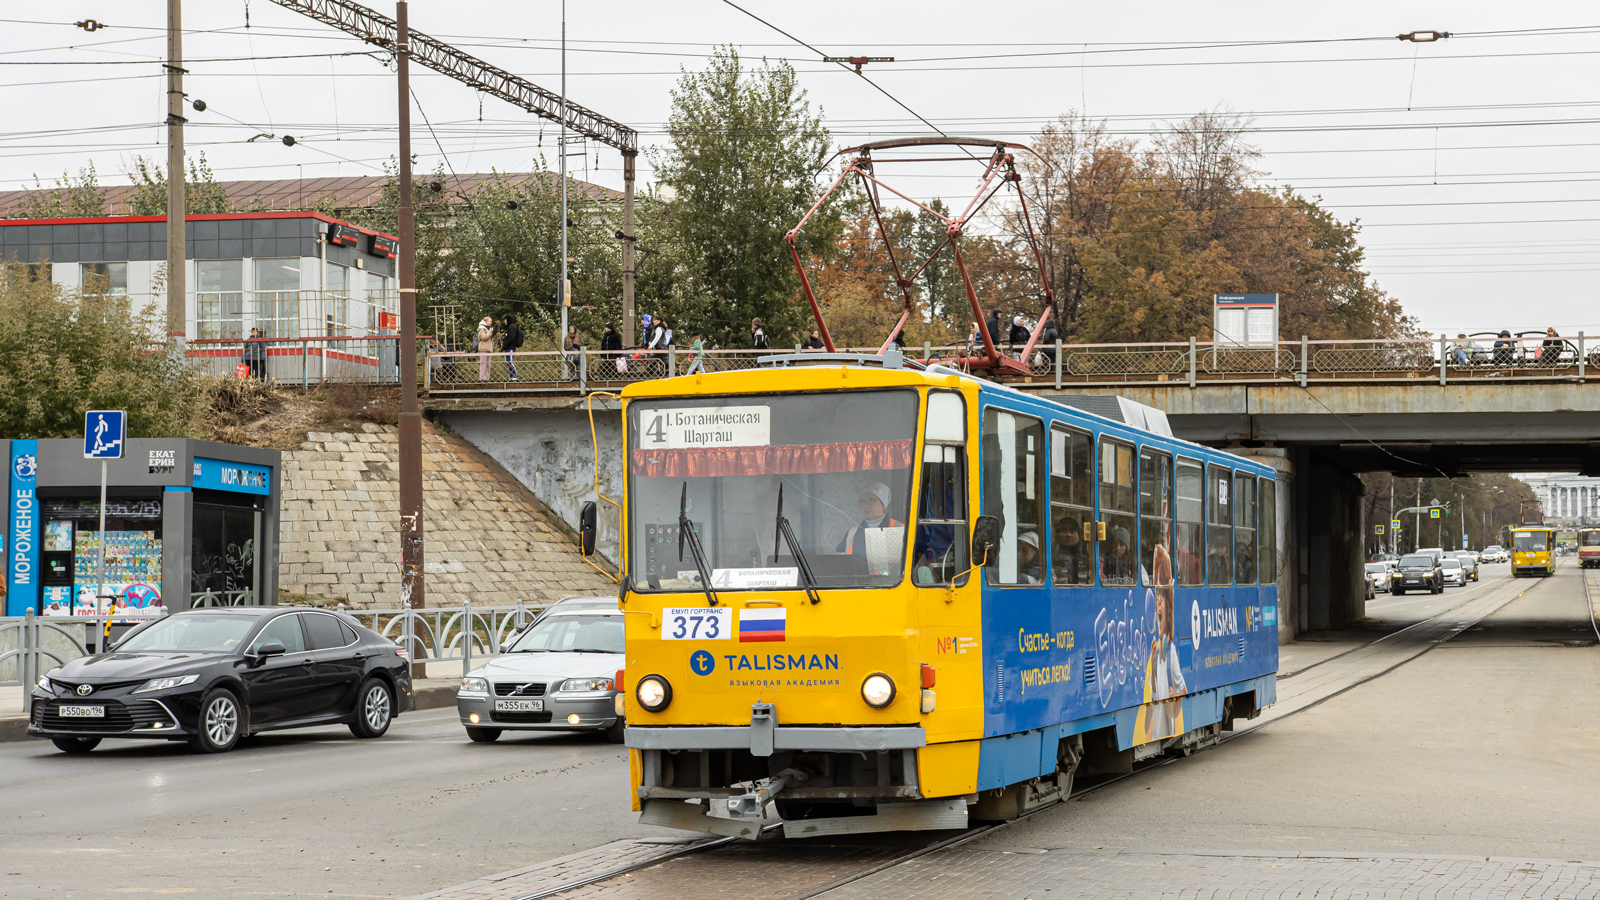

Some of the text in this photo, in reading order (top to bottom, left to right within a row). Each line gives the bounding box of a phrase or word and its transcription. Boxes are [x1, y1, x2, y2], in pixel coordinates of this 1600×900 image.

[645, 415, 667, 443] 4
[675, 412, 761, 427] Ботаническая
[684, 430, 733, 445] Шарташ
[149, 450, 175, 458] ЕКАТ
[149, 458, 175, 466] ЕРИН
[221, 467, 267, 488] МОРОЖЕНОЕ
[14, 489, 32, 584] МОРОЖЕНОЕ
[672, 615, 720, 639] 373
[1202, 607, 1238, 638] TALISMAN
[937, 636, 958, 655] №1
[1018, 627, 1050, 653] Счастье
[1056, 630, 1075, 651] когда
[724, 653, 839, 671] TALISMAN
[729, 679, 840, 687] ЯЗЫКОВАЯ АКАДЕМИЯ
[1020, 657, 1071, 696] учиться легко!
